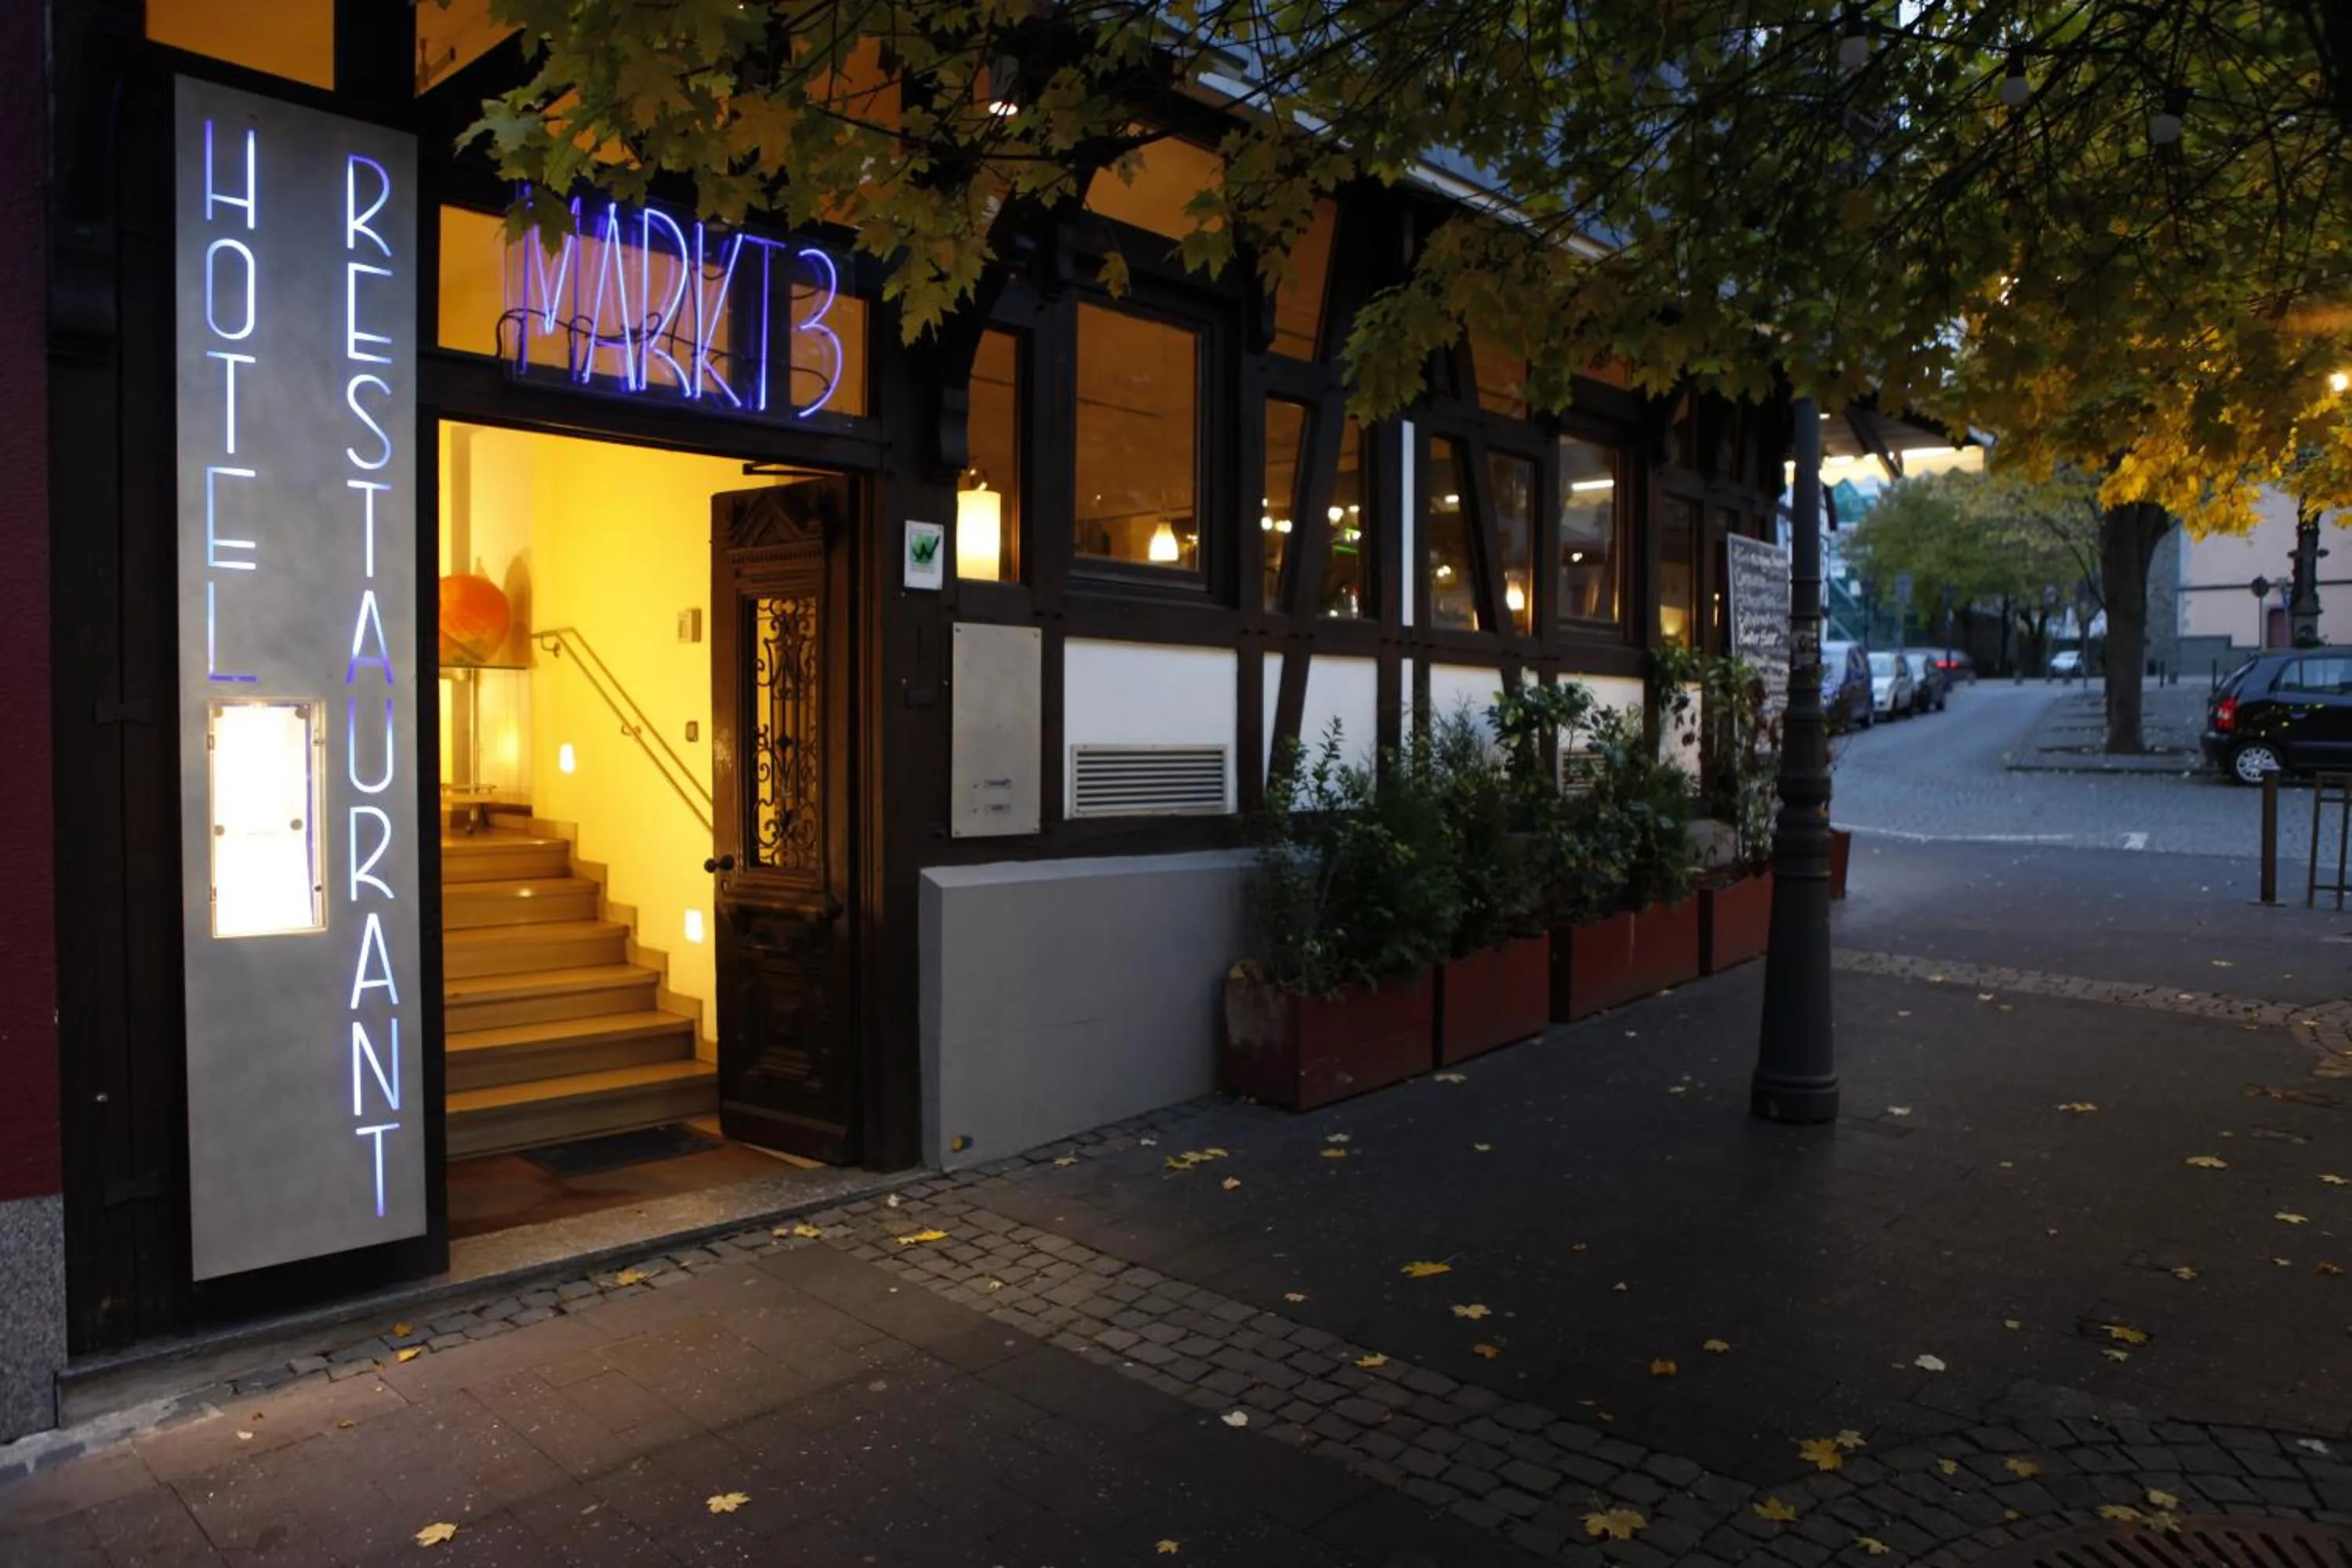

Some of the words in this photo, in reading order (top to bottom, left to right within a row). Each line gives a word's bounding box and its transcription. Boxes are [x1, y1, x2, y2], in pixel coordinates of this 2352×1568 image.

[205, 118, 257, 682] HOTEL
[518, 183, 787, 412] MARKT
[797, 248, 844, 418] 3
[346, 154, 401, 1217] RESTAURANT
